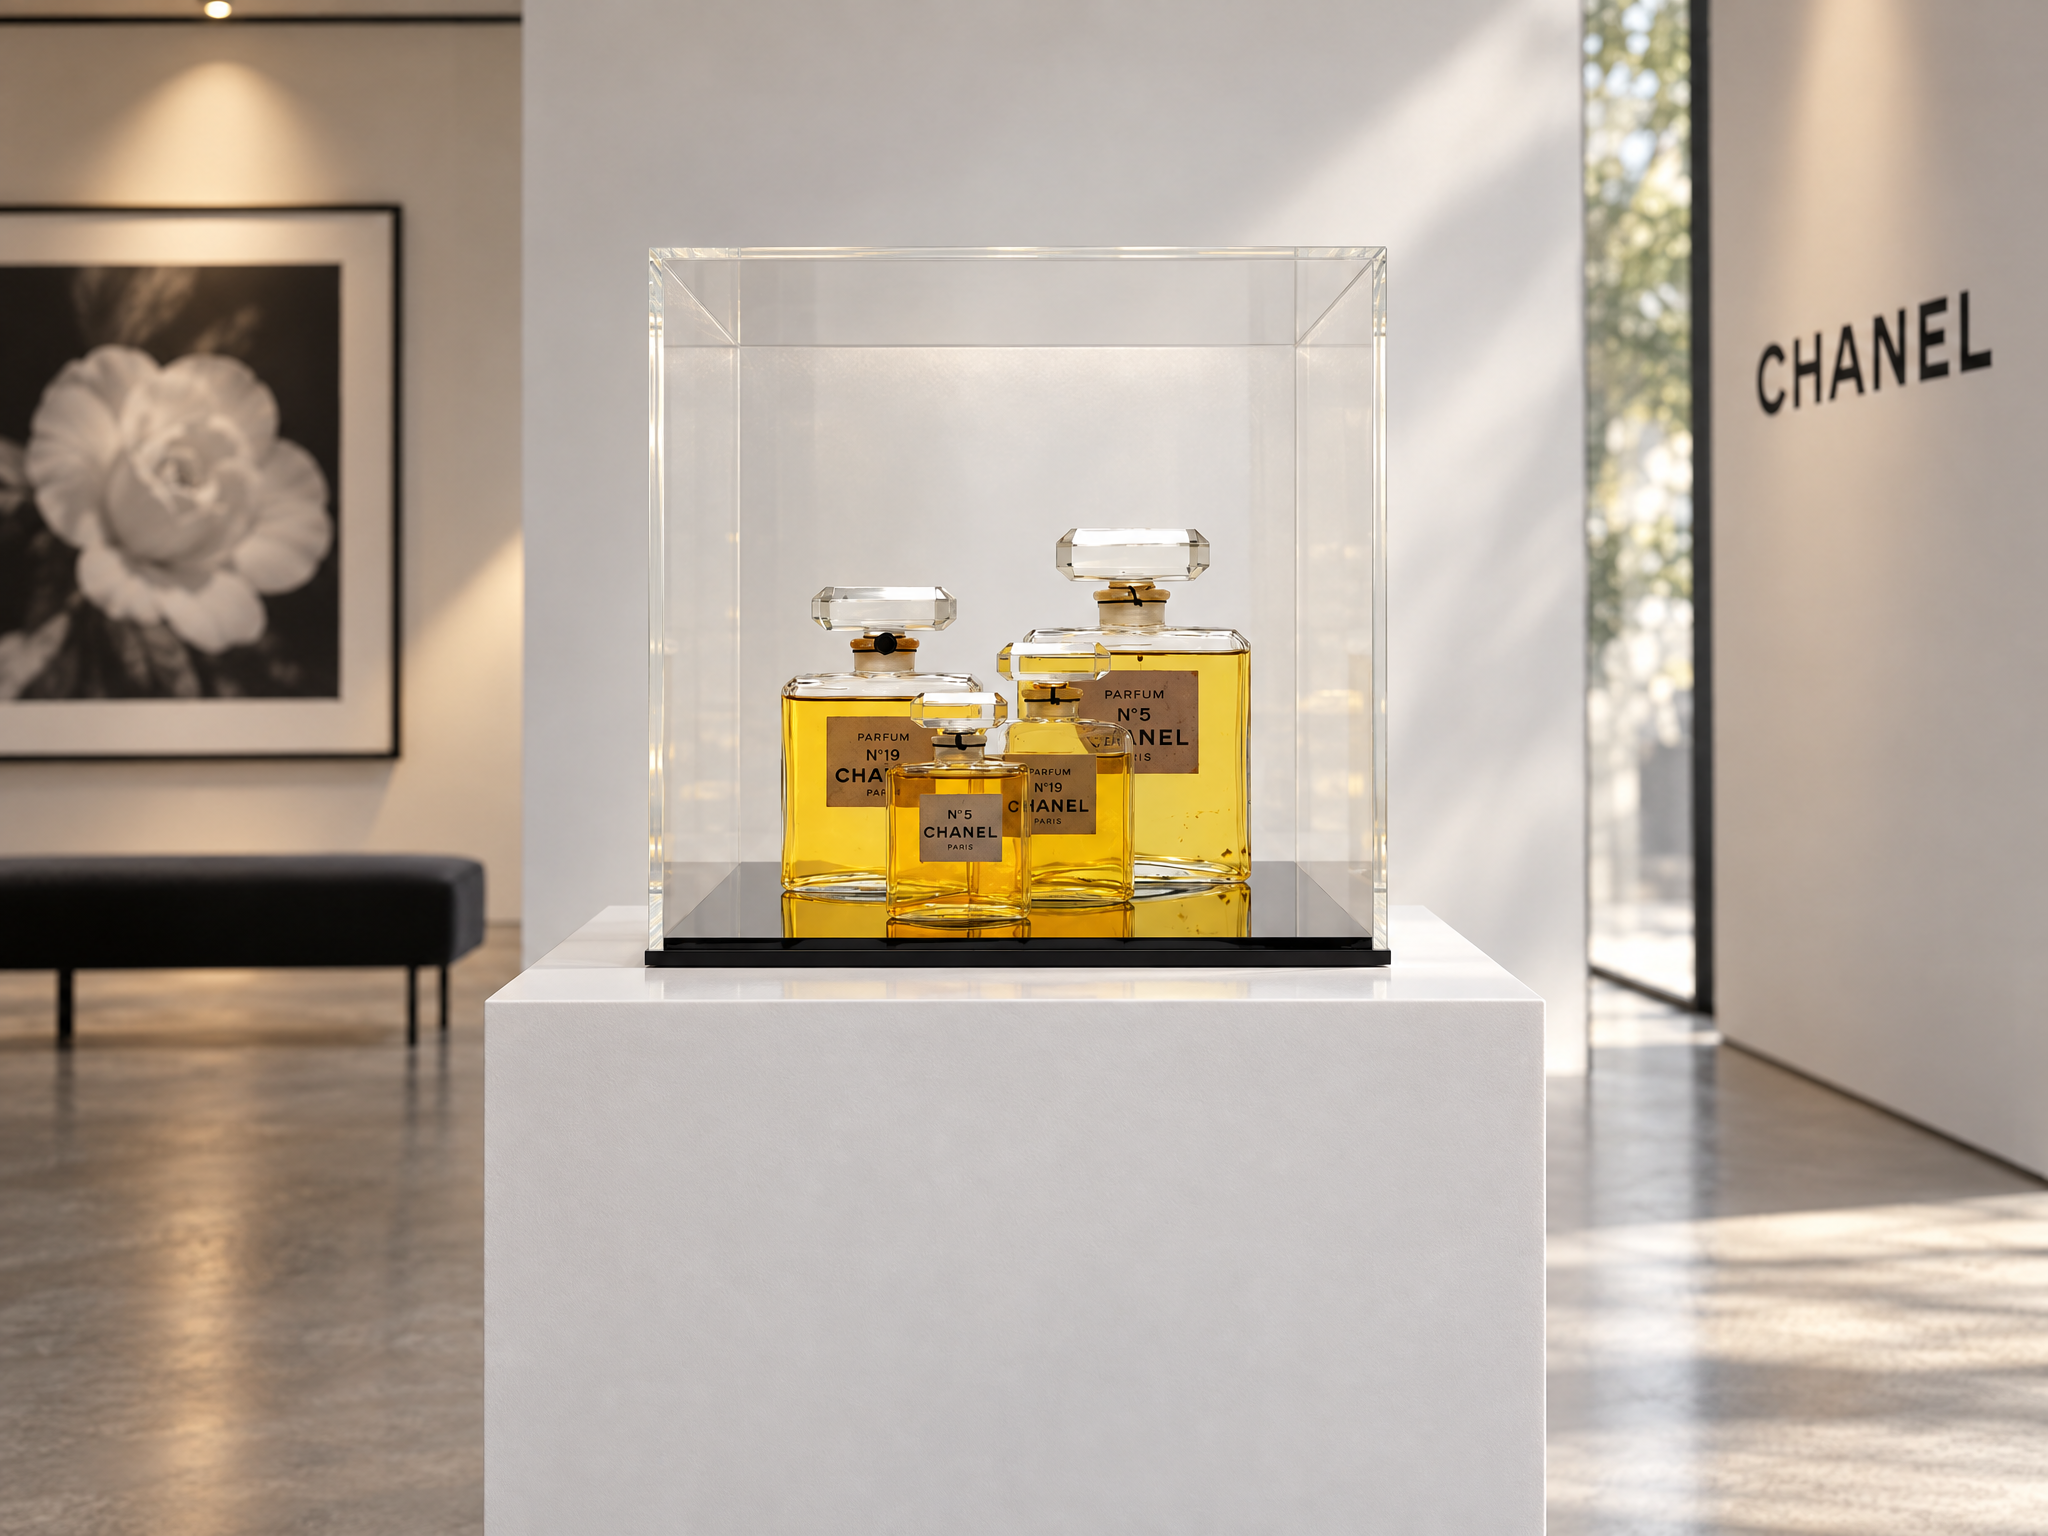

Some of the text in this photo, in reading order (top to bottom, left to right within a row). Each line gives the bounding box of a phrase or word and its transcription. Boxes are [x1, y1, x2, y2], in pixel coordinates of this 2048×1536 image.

[1757, 289, 1992, 417] CHANEL
[1105, 690, 1164, 699] PARFUM
[857, 733, 909, 741] PARFUM
[835, 768, 888, 783] CHA
[924, 826, 998, 838] CHANEL
